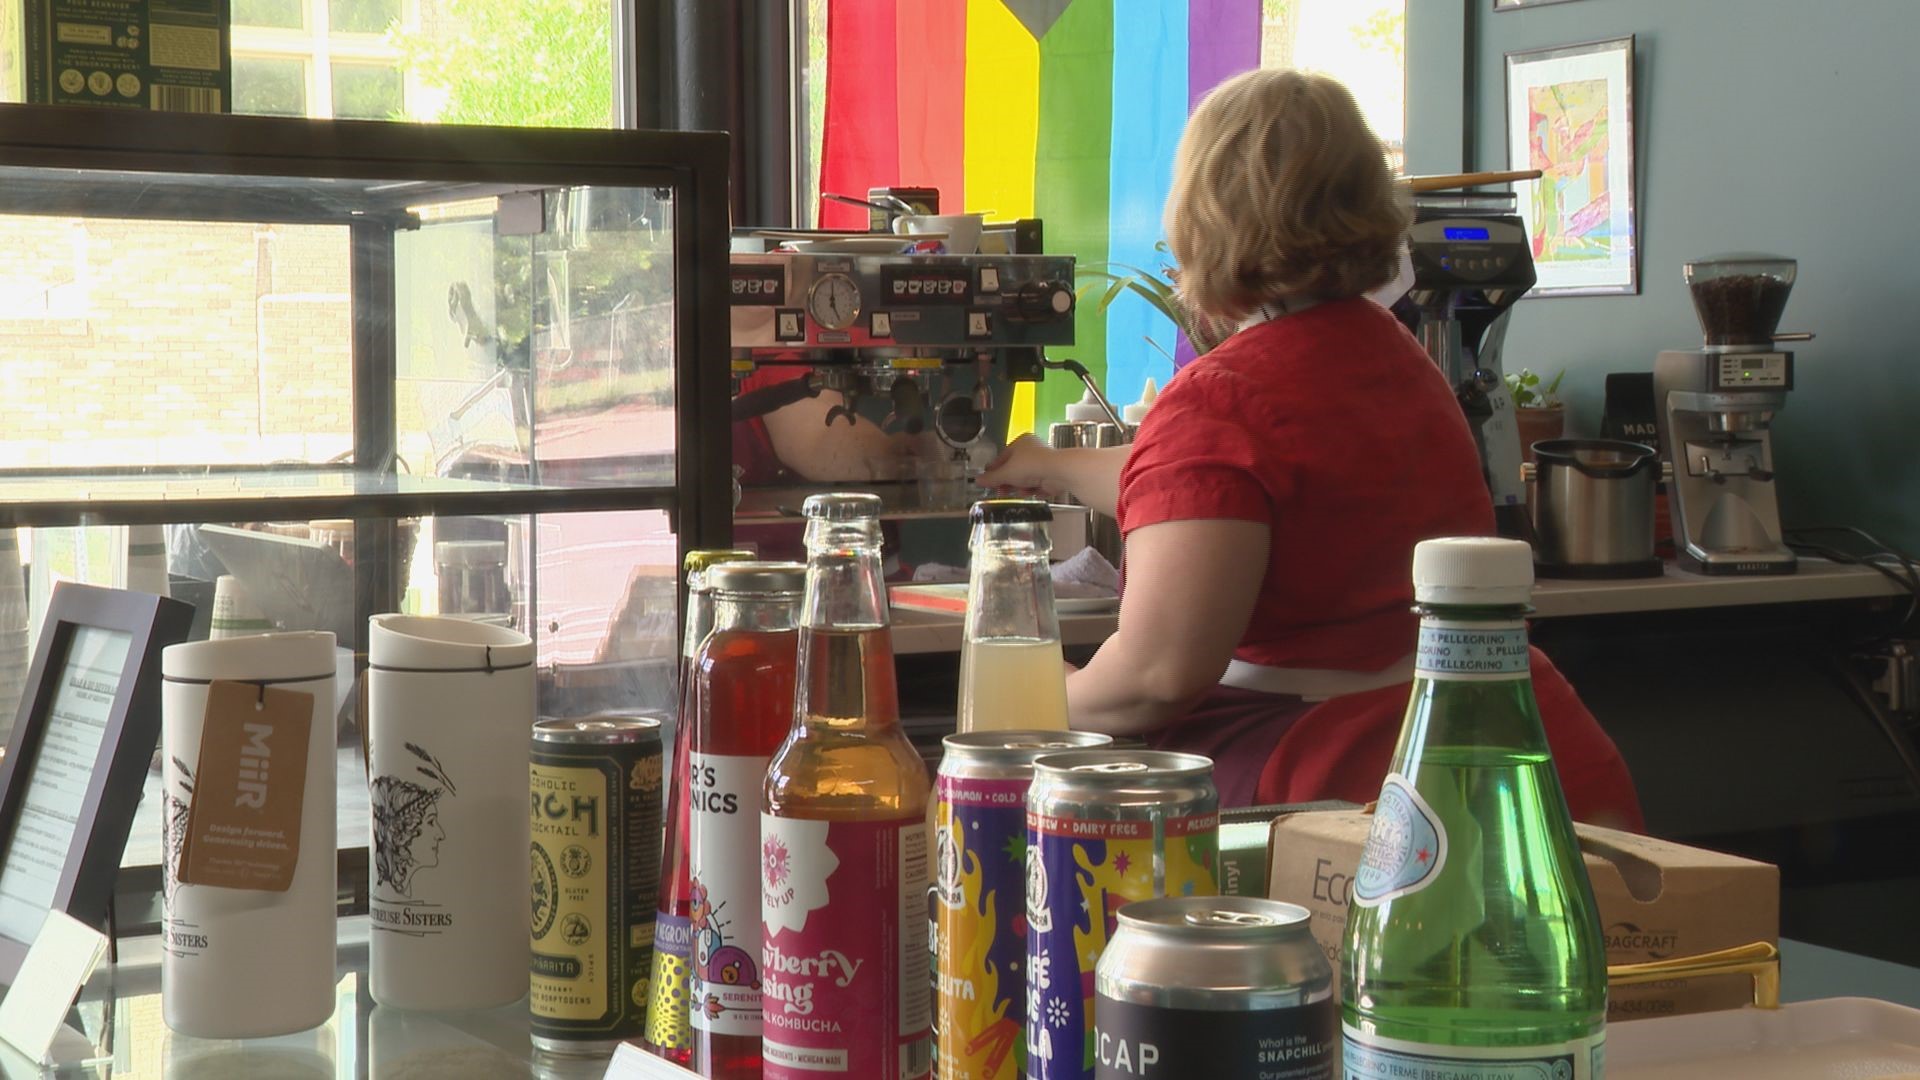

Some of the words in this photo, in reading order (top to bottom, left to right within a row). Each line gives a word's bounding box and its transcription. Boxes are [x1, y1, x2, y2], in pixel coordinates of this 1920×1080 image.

[1623, 423, 1656, 436] MAD
[234, 722, 274, 809] MiiR
[691, 789, 738, 814] NICS
[992, 793, 1017, 803] COLD
[1073, 822, 1106, 834] DAIRY
[1110, 823, 1138, 835] FREE
[782, 887, 795, 905] UP
[403, 907, 453, 927] SISTERS
[1605, 935, 1679, 949] BAGCRAFT
[771, 1012, 842, 1033] KOMBUCHA
[1258, 1037, 1284, 1049] What
[1285, 1036, 1293, 1046] is
[1258, 1042, 1321, 1063] SNAPCHILL
[824, 1055, 841, 1065] MADE
[1259, 1071, 1275, 1080] Our
[1389, 1064, 1418, 1079] TERME
